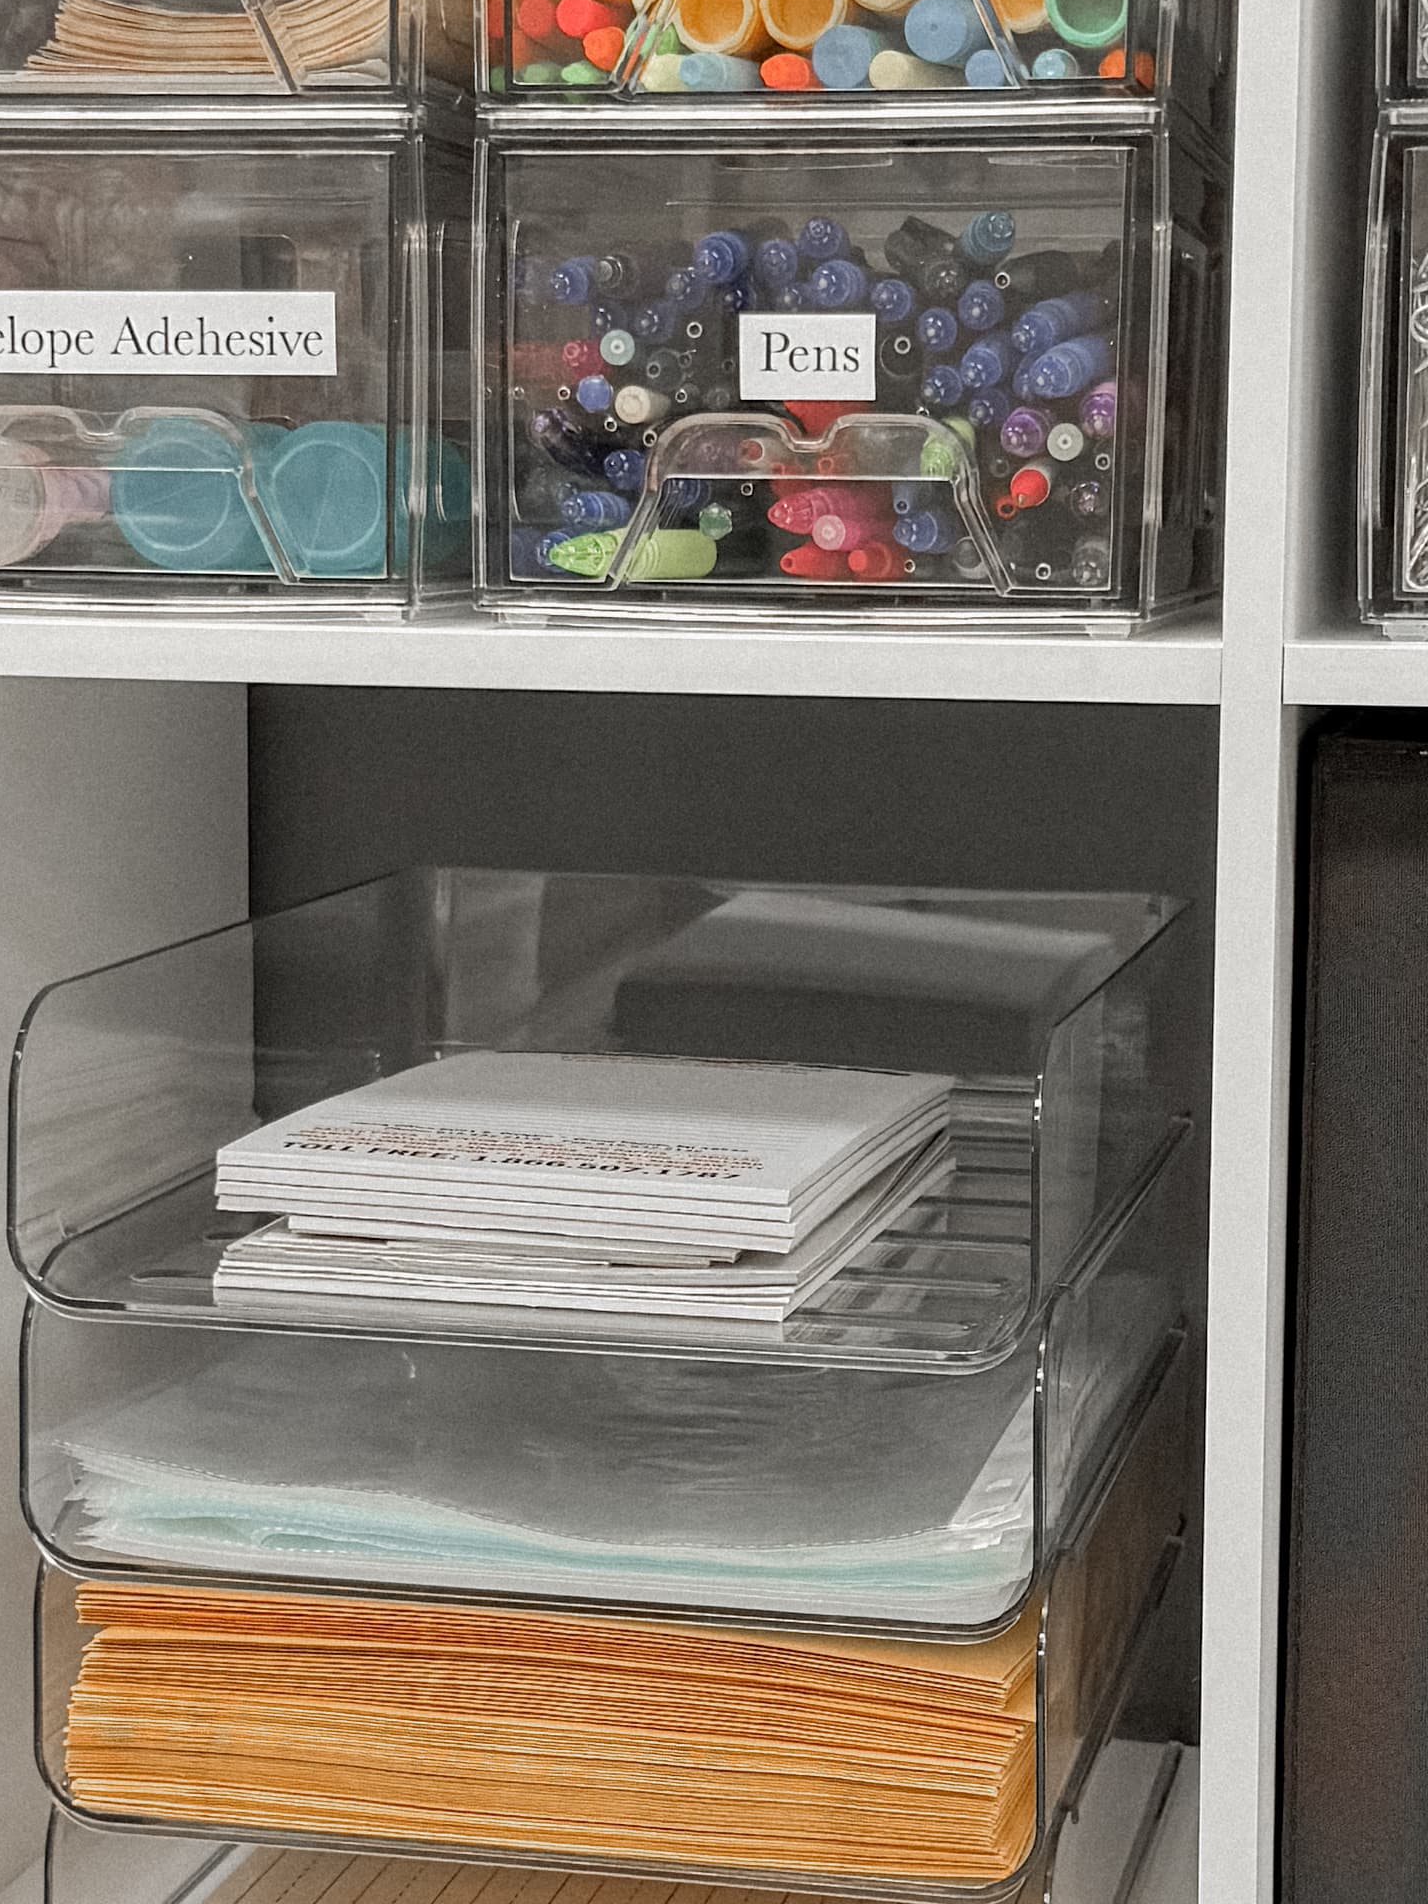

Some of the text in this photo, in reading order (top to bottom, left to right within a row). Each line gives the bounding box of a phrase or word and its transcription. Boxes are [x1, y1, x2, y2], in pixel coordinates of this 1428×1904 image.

[110, 315, 324, 358] Adehesive
[759, 331, 862, 374] Pens
[283, 1141, 356, 1154] TOLL
[367, 1147, 460, 1162] FREE:
